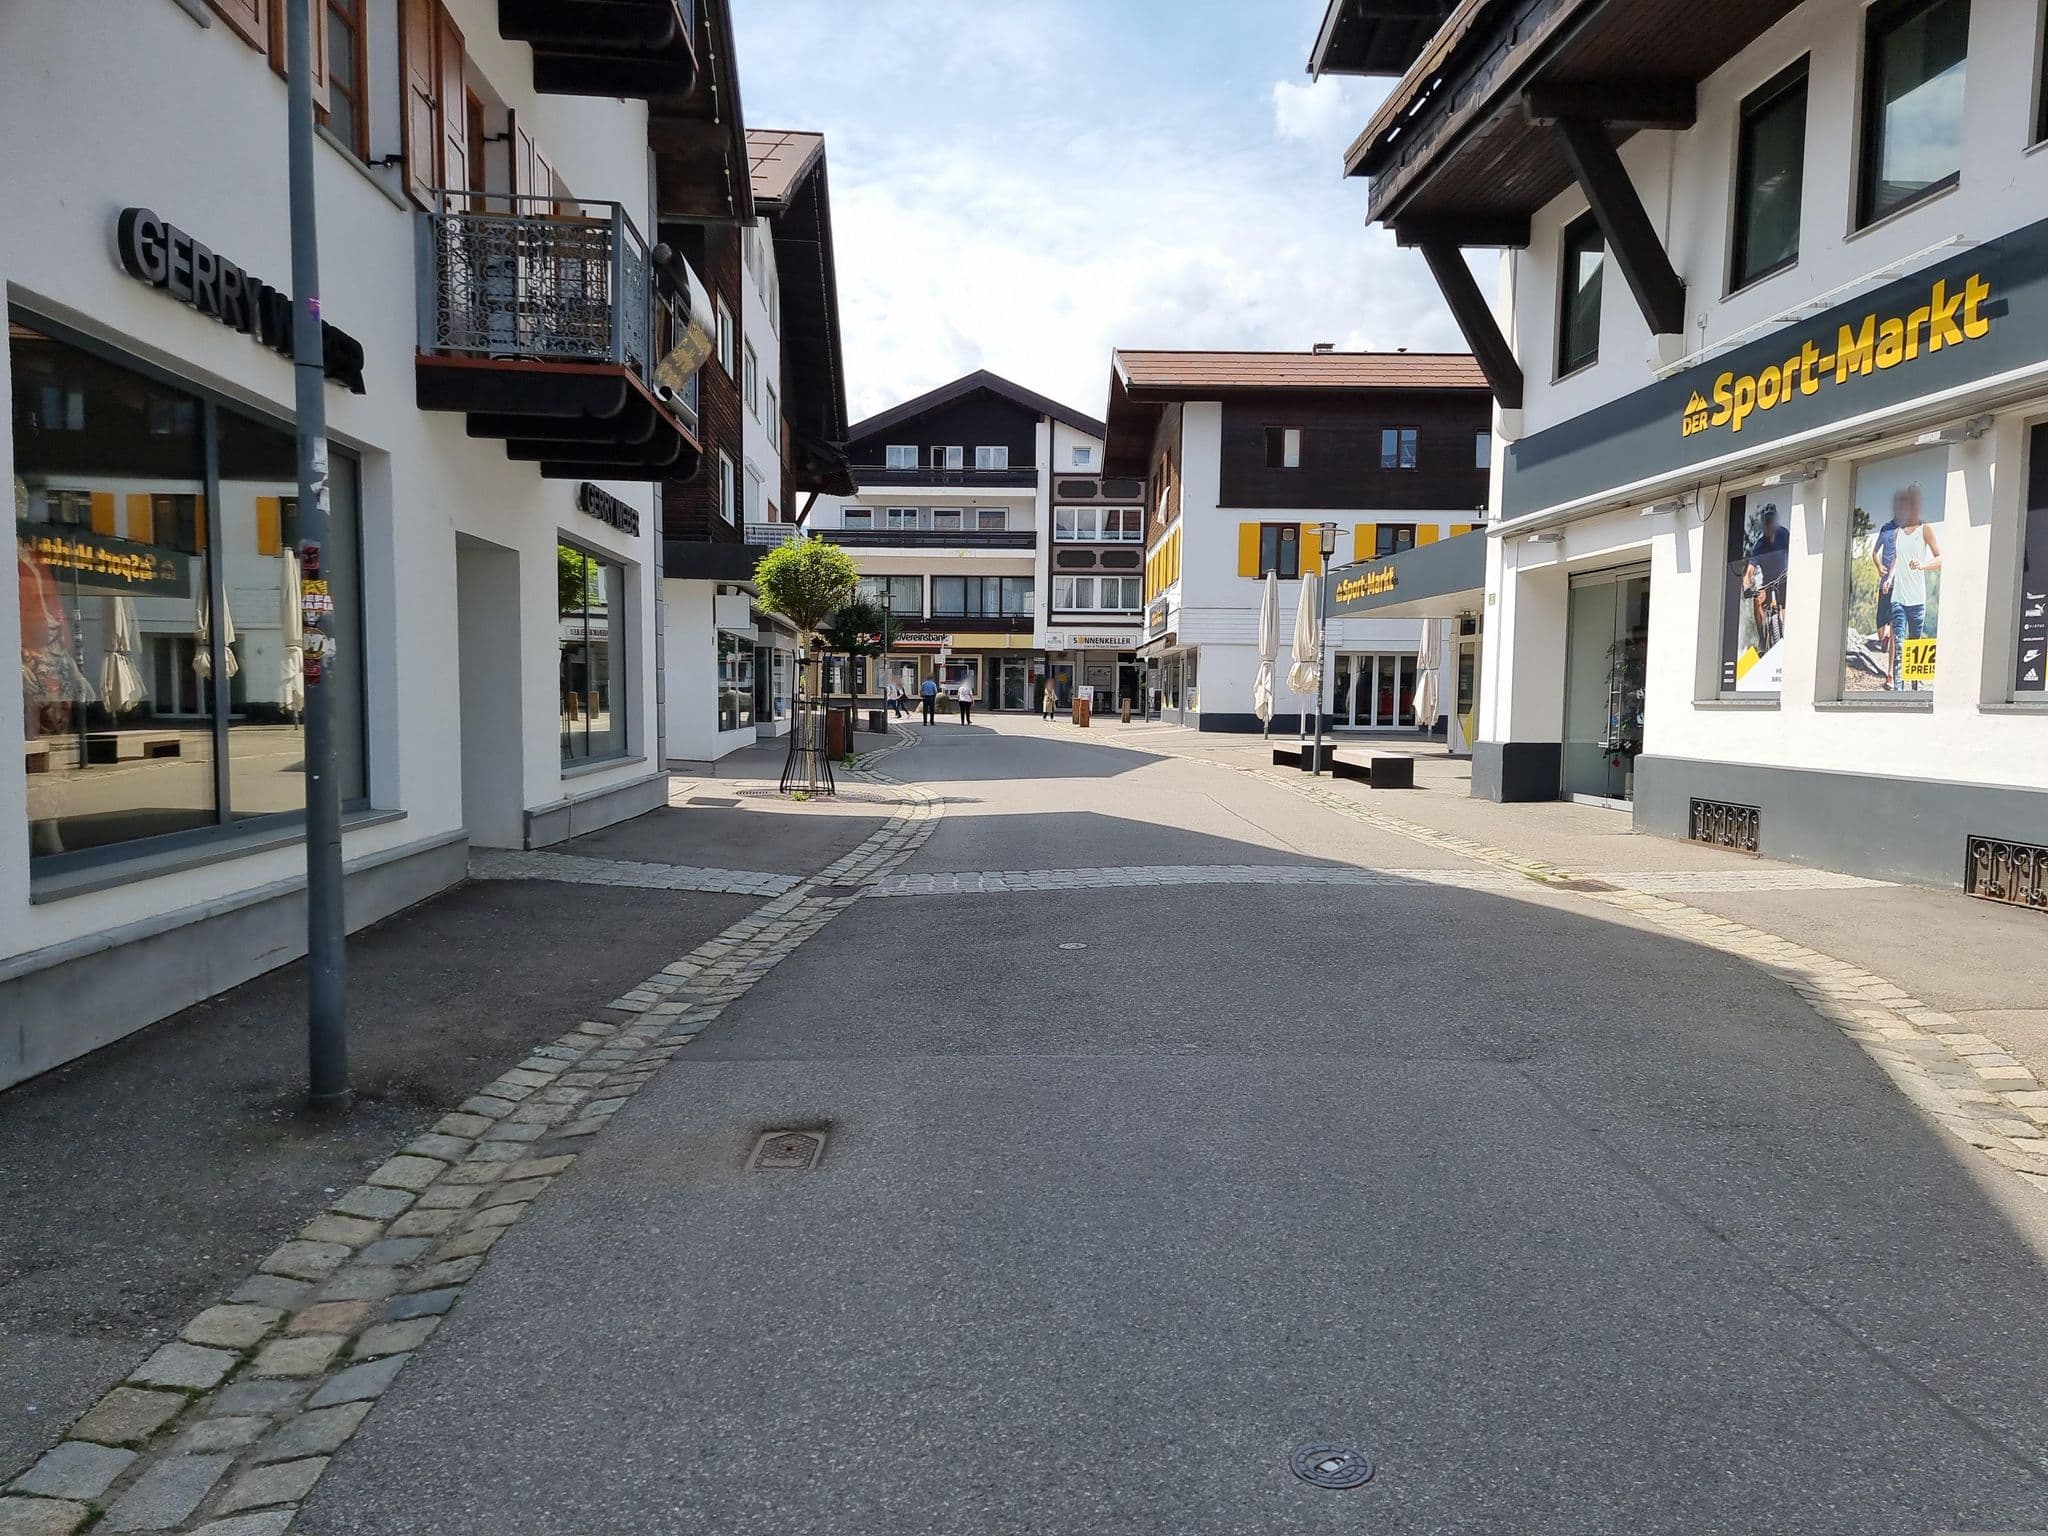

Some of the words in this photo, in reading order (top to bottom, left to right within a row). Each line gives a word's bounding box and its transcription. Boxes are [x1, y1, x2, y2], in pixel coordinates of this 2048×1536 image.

[118, 207, 263, 334] GERRY
[1682, 411, 1709, 438] DER
[1711, 273, 1990, 433] Sport-Markt
[581, 482, 615, 523] GERRY
[612, 498, 640, 537] WEBER
[1912, 645, 1936, 664] 1/2
